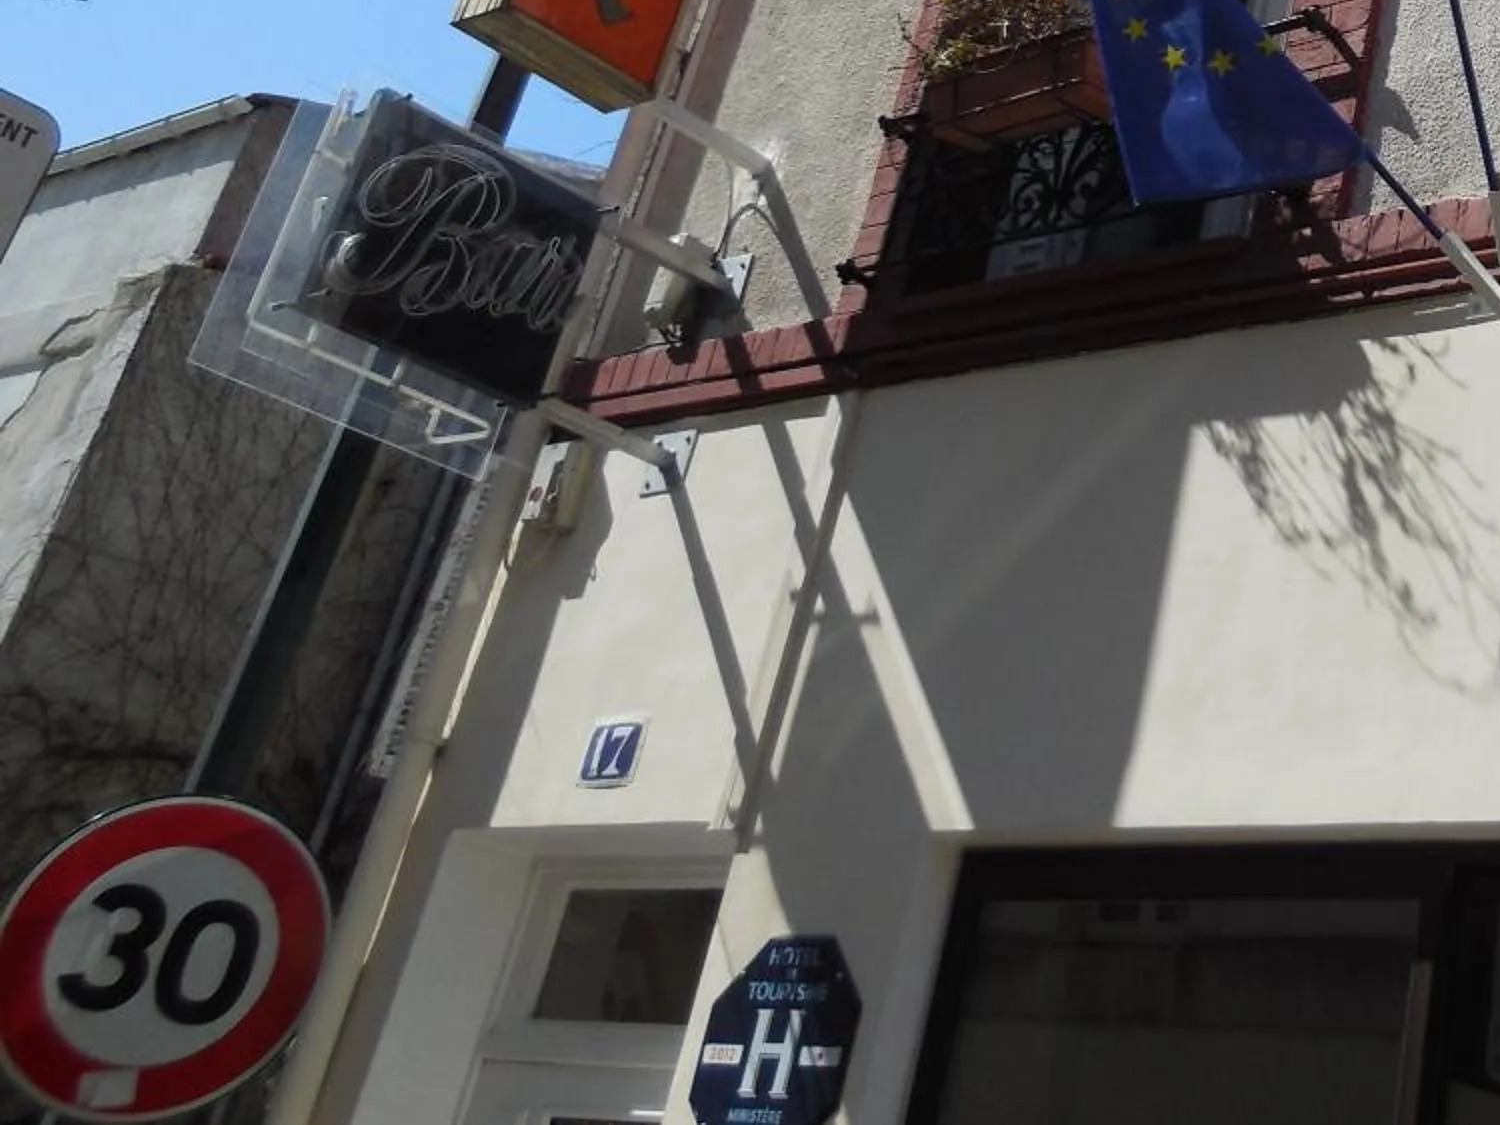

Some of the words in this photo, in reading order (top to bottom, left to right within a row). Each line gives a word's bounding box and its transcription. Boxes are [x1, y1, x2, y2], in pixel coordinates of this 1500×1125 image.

[587, 726, 635, 777] 17
[57, 883, 260, 1025] 30
[737, 1008, 807, 1099] H
